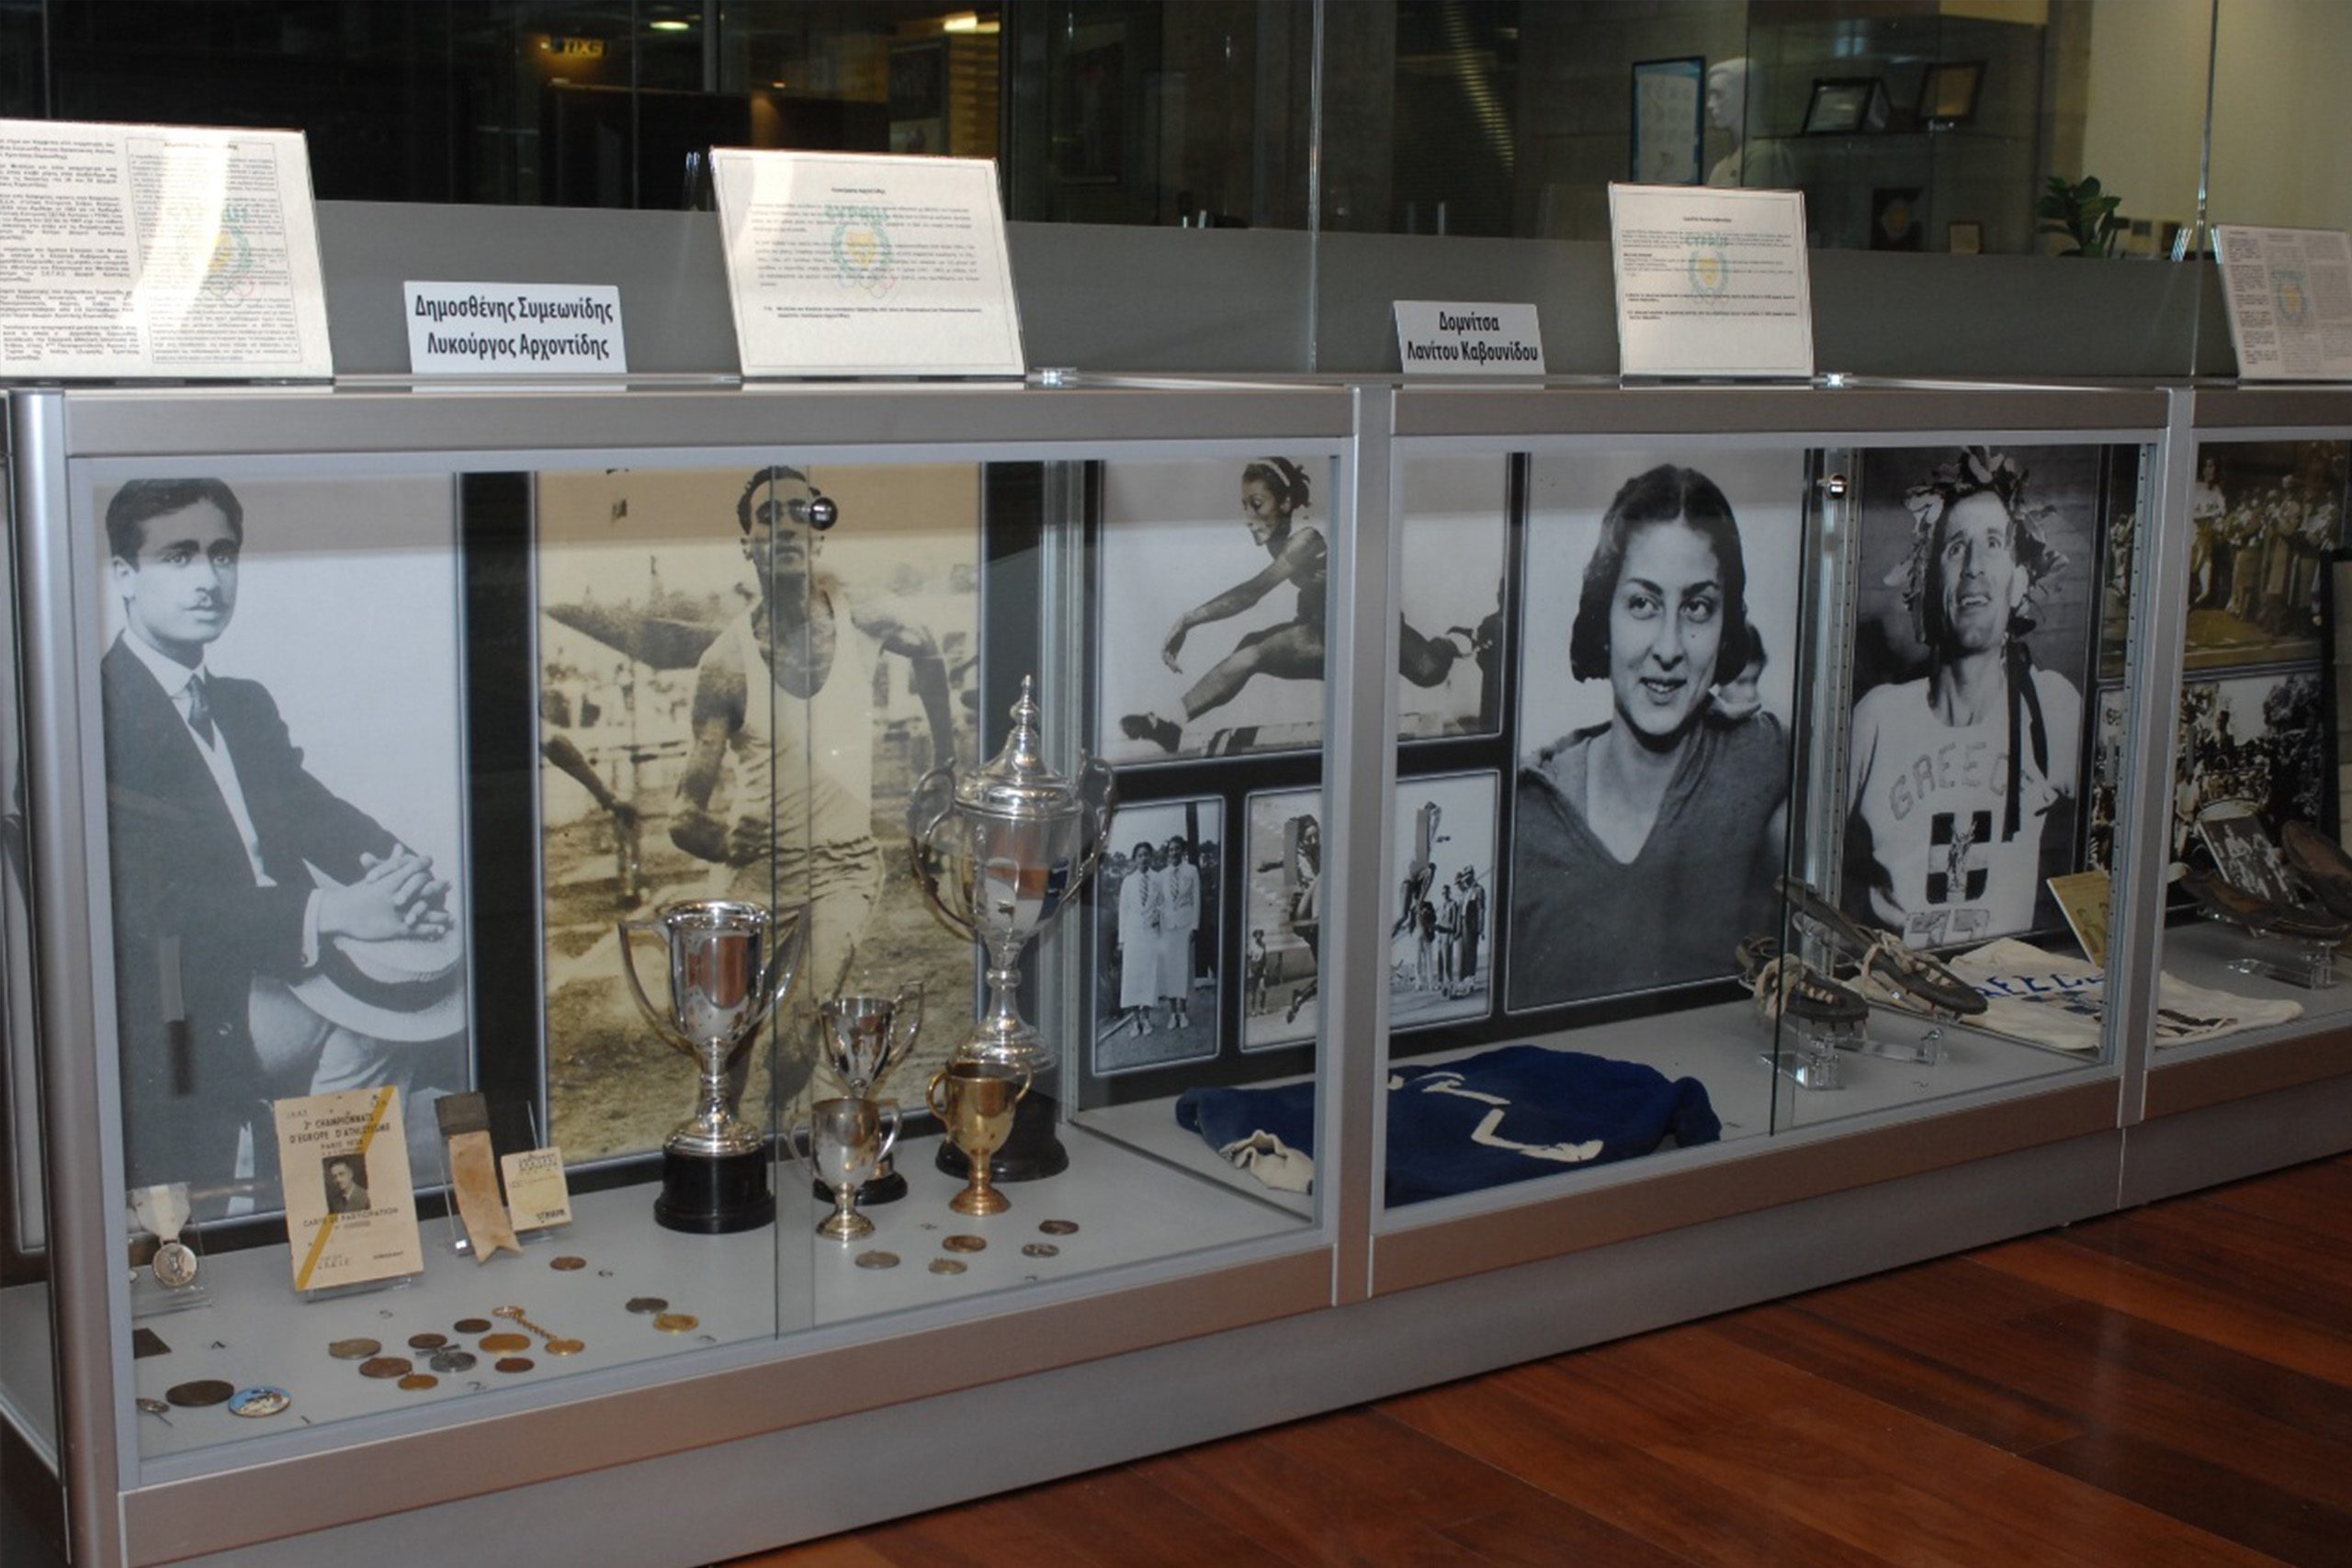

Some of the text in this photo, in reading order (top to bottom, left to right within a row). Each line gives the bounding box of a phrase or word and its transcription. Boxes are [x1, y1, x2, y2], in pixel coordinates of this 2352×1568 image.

[415, 294, 614, 324] Δημοσθένης Συμεωνίδης
[1439, 310, 1499, 335] Δομνίτσα
[427, 332, 609, 361] Λυκούργος Αρχοντίδης
[1408, 340, 1538, 366] Λανίτου Καβουνίδου
